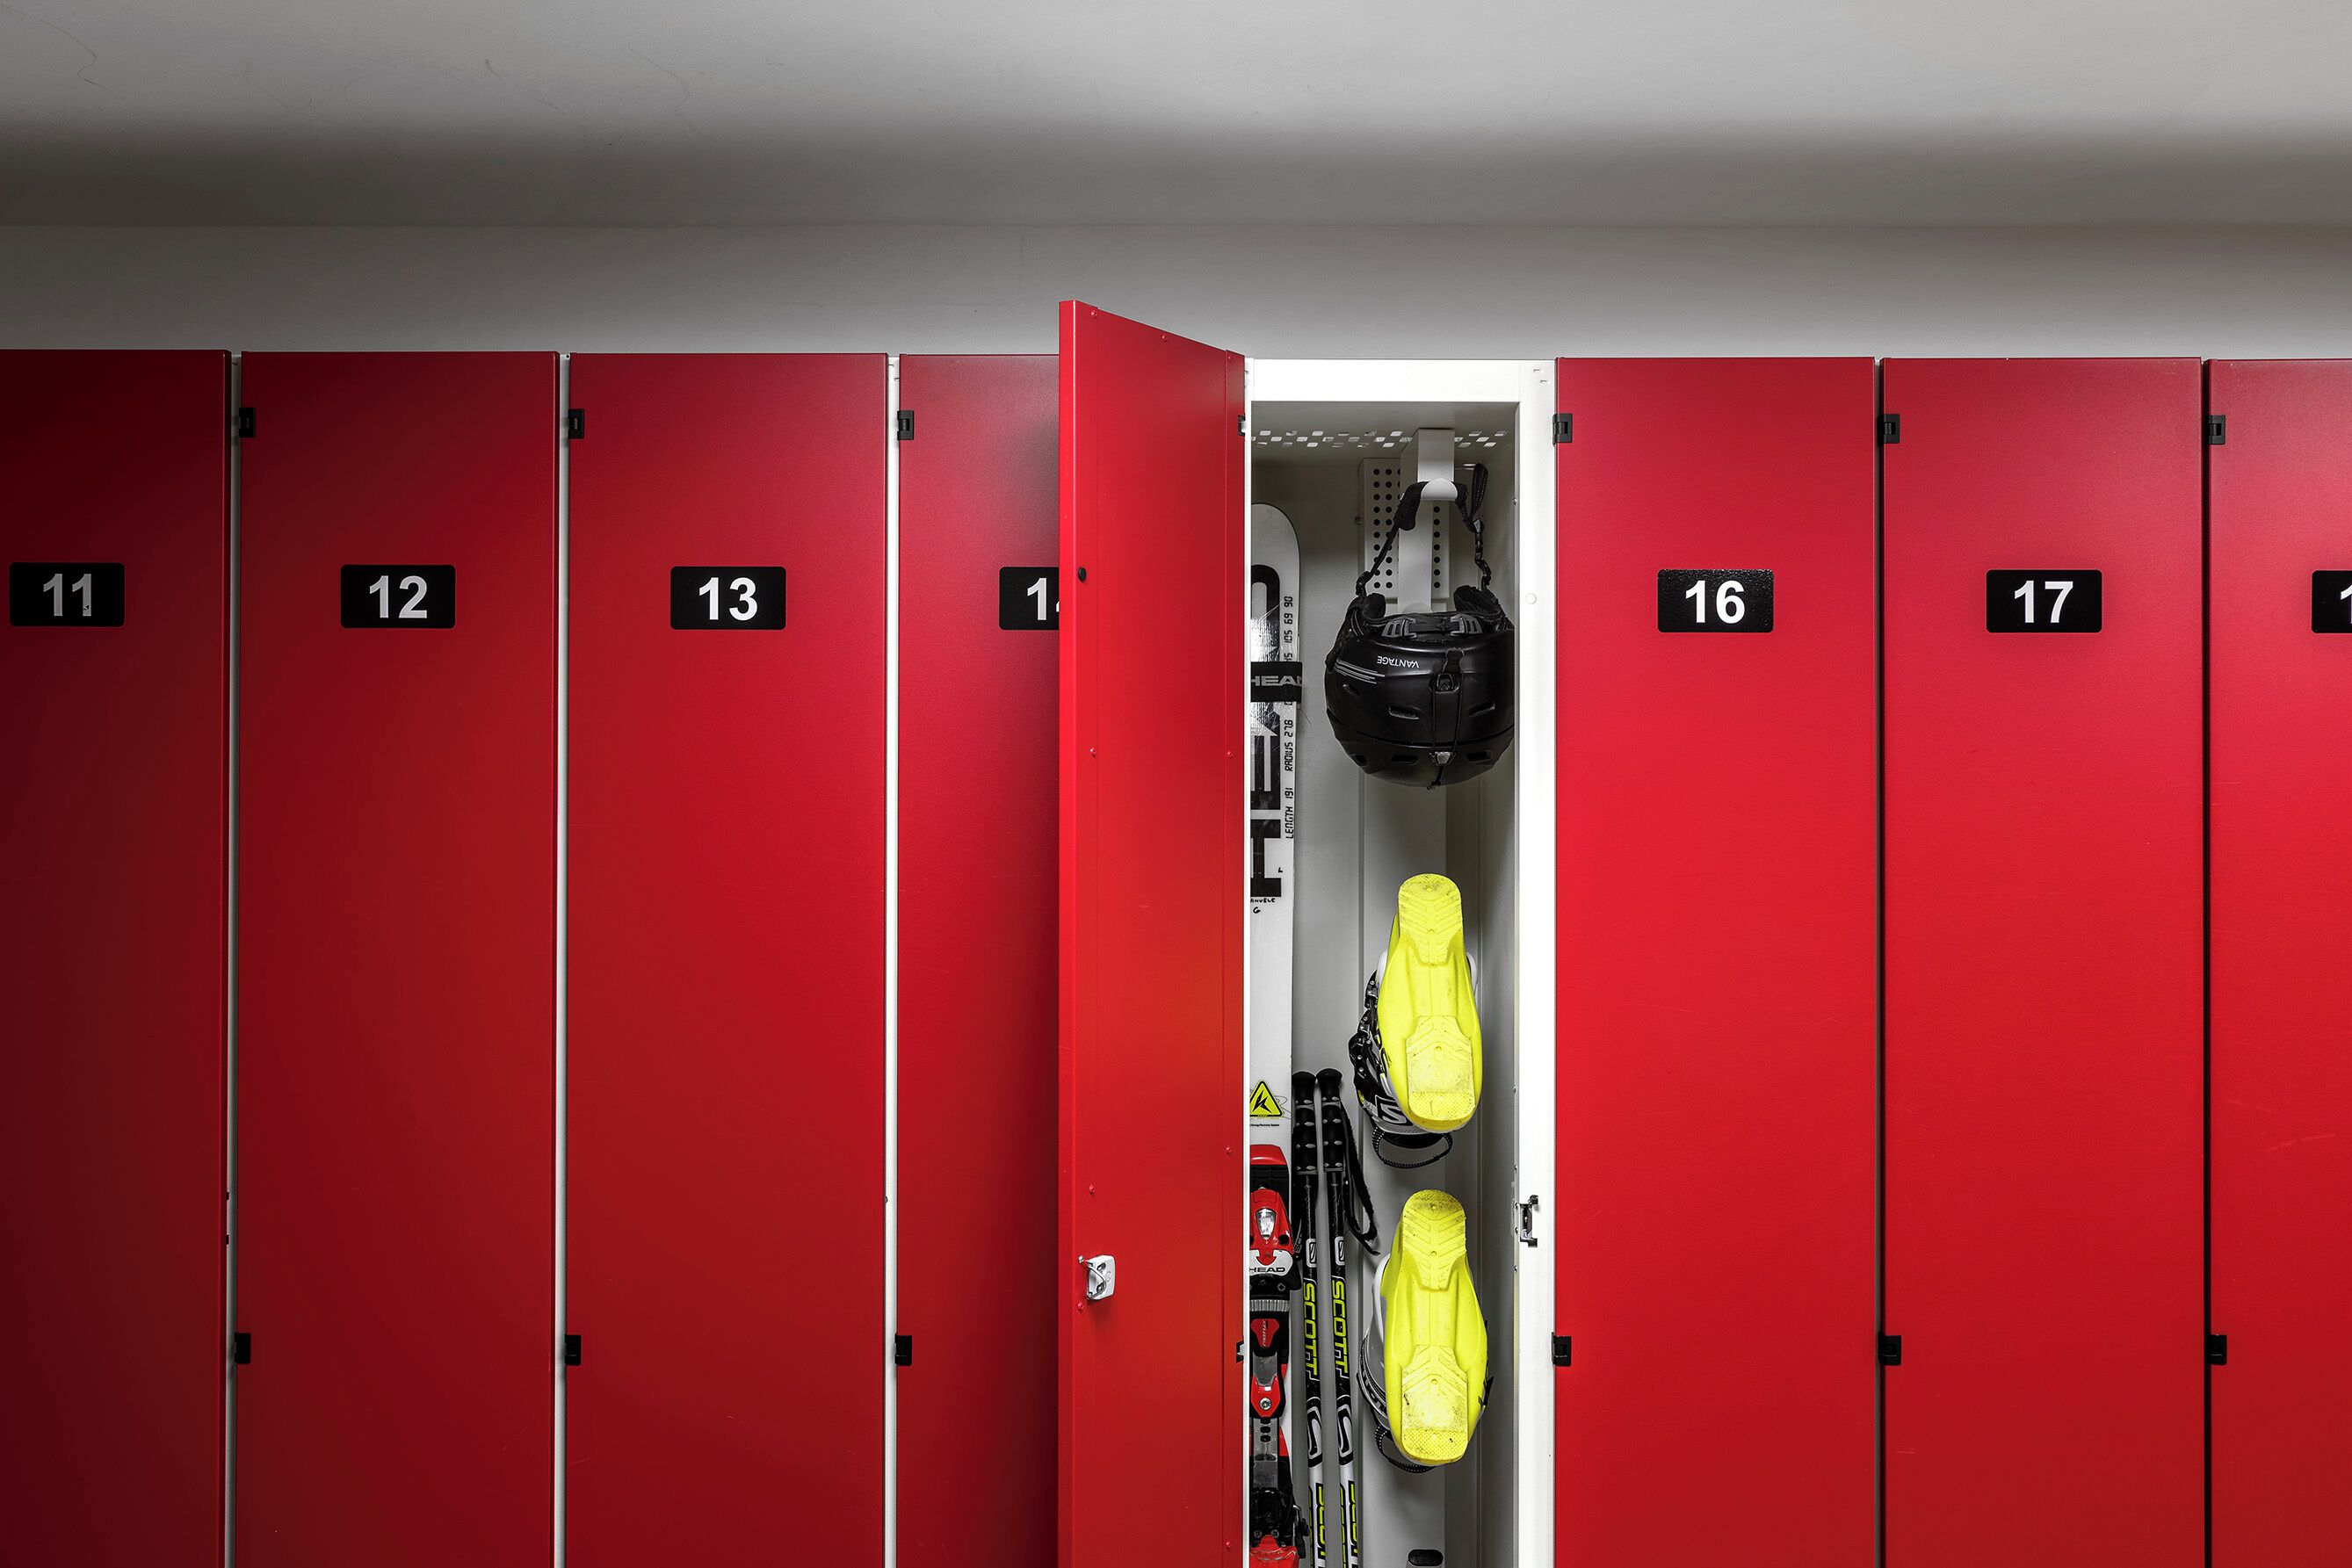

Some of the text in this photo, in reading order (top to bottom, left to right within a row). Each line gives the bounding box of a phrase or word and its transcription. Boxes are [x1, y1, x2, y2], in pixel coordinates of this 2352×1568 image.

[44, 574, 91, 616] 11
[370, 575, 427, 618] 12
[698, 577, 757, 620] 13
[1027, 578, 1060, 620] 1
[1285, 596, 1293, 607] 90
[1684, 580, 1745, 623] 16
[2014, 581, 2074, 623] 17
[1285, 613, 1293, 625] 69
[1285, 630, 1293, 644] 105
[1377, 655, 1420, 668] VANTAGE
[1251, 675, 1302, 687] HEA
[1285, 742, 1293, 771] RADIUS
[1285, 787, 1293, 798] 191
[1285, 806, 1294, 839] LENGTH
[1303, 1282, 1318, 1376] SCOTT
[1331, 1280, 1349, 1374] SCOTT
